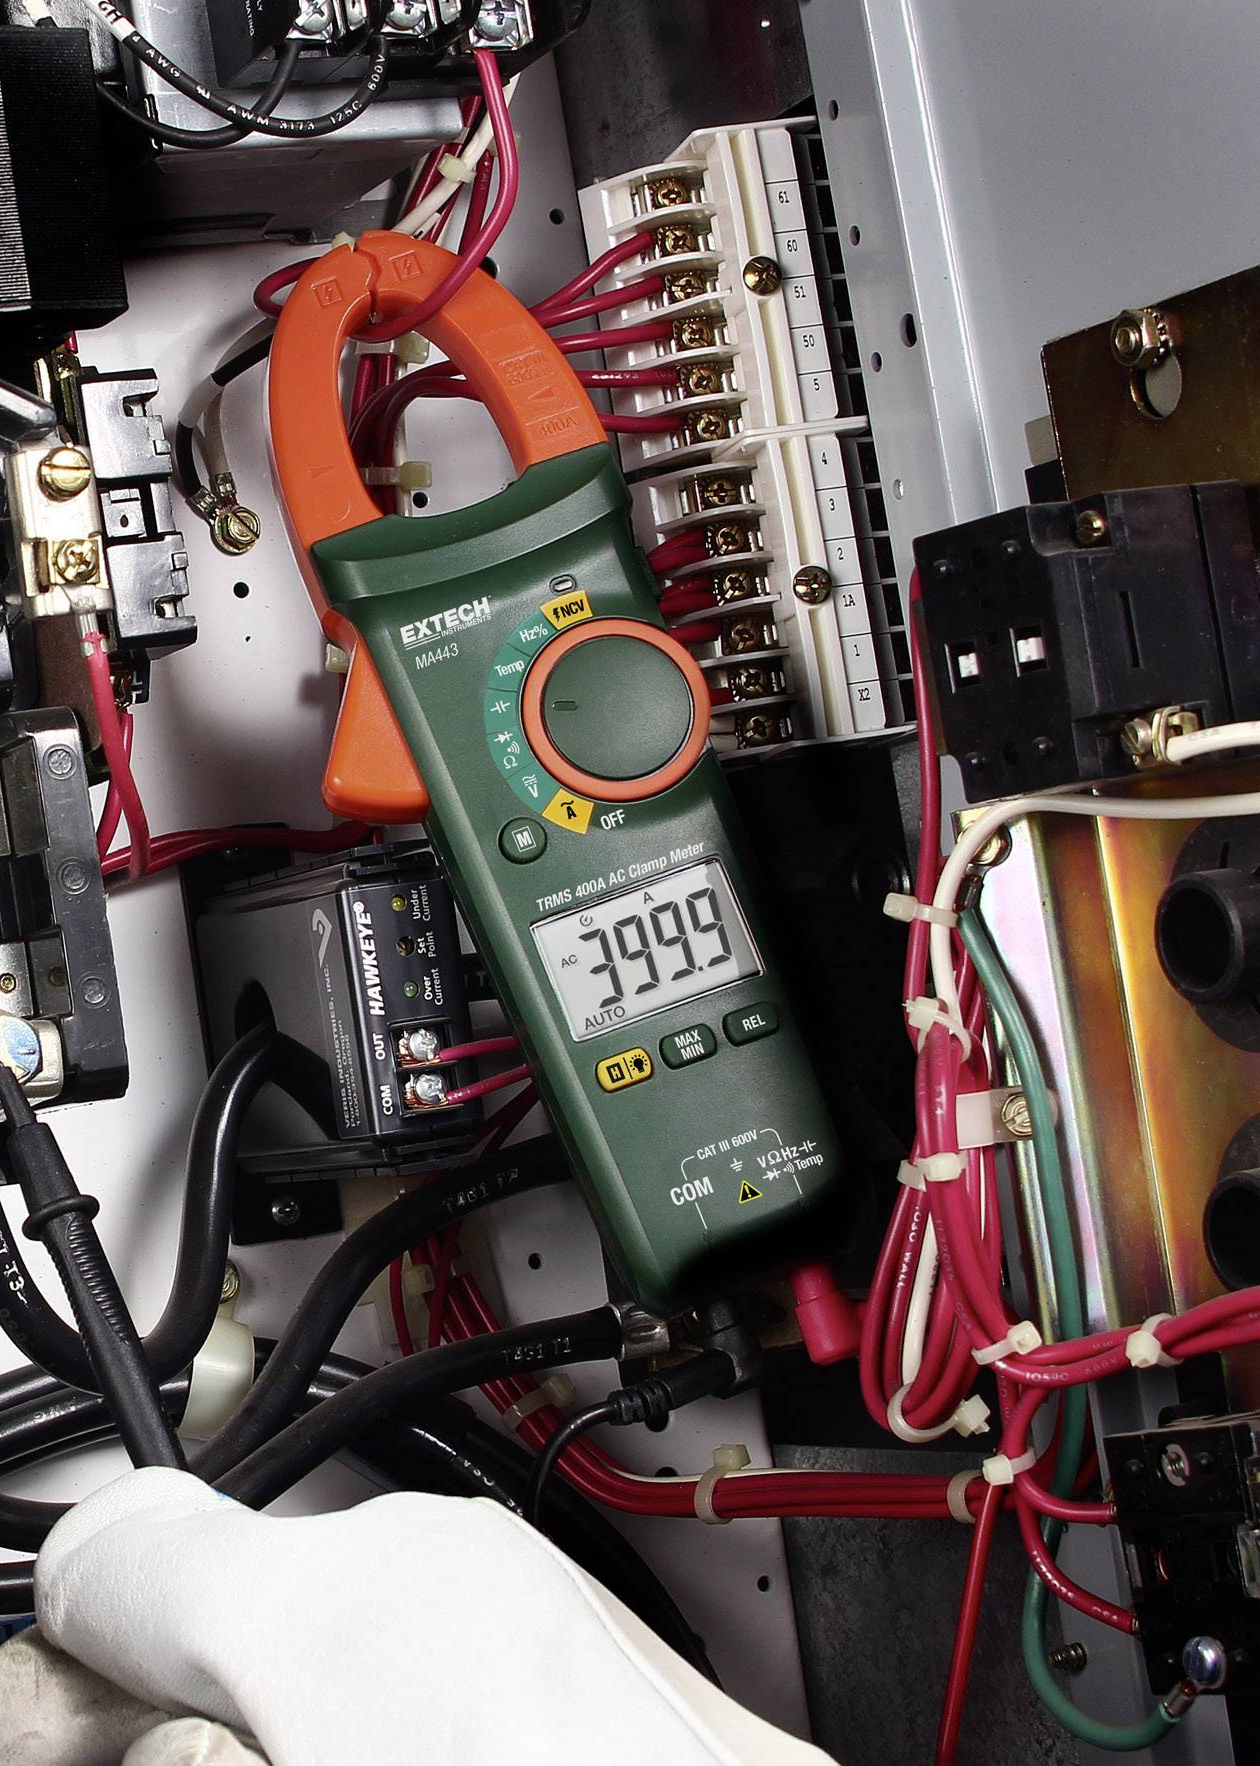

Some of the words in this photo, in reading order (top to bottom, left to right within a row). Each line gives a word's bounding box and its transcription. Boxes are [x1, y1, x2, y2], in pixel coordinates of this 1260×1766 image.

[145, 48, 181, 78] AWG
[227, 103, 270, 127] AWM
[367, 53, 386, 92] 600V
[778, 189, 790, 205] 61
[786, 239, 798, 253] 60
[794, 285, 806, 299] 51
[802, 334, 815, 349] 50
[814, 378, 820, 392] 5
[539, 414, 579, 436] 400A
[821, 452, 828, 465] 4
[828, 498, 836, 512] 3
[836, 546, 844, 561] 2
[560, 598, 586, 618] NCV
[842, 593, 856, 609] 1A
[399, 596, 491, 645] EXTECH
[440, 613, 492, 638] INSTRUMENTS
[518, 624, 549, 644] Hz%
[414, 642, 460, 670] MA443
[854, 644, 861, 657] 1
[494, 658, 526, 678] Temp
[858, 687, 871, 702] X2
[600, 808, 626, 830] OFF
[516, 830, 533, 848] M
[535, 888, 573, 912] TRMS
[576, 878, 607, 899] 400A
[608, 869, 626, 889] AC
[628, 854, 668, 878] Clamp
[670, 841, 706, 860] Meter
[411, 888, 422, 920] Under
[422, 884, 430, 922] Current
[642, 891, 654, 905] A
[417, 936, 427, 954] Set
[426, 930, 436, 958] Point
[578, 886, 733, 1010] 399.9
[560, 954, 578, 969] AC
[423, 976, 434, 1001] Over
[430, 968, 444, 1006] Current
[584, 1005, 626, 1031] AUTO
[742, 1013, 766, 1032] REL
[372, 1032, 386, 1061] OUT
[674, 1029, 702, 1049] MAX
[680, 1042, 705, 1061] MIN
[379, 1084, 394, 1116] COM
[696, 1144, 718, 1161] CAT
[718, 1138, 731, 1154] III
[732, 1128, 759, 1148] 600V
[794, 1153, 824, 1172] Temp
[669, 1176, 714, 1206] COM
